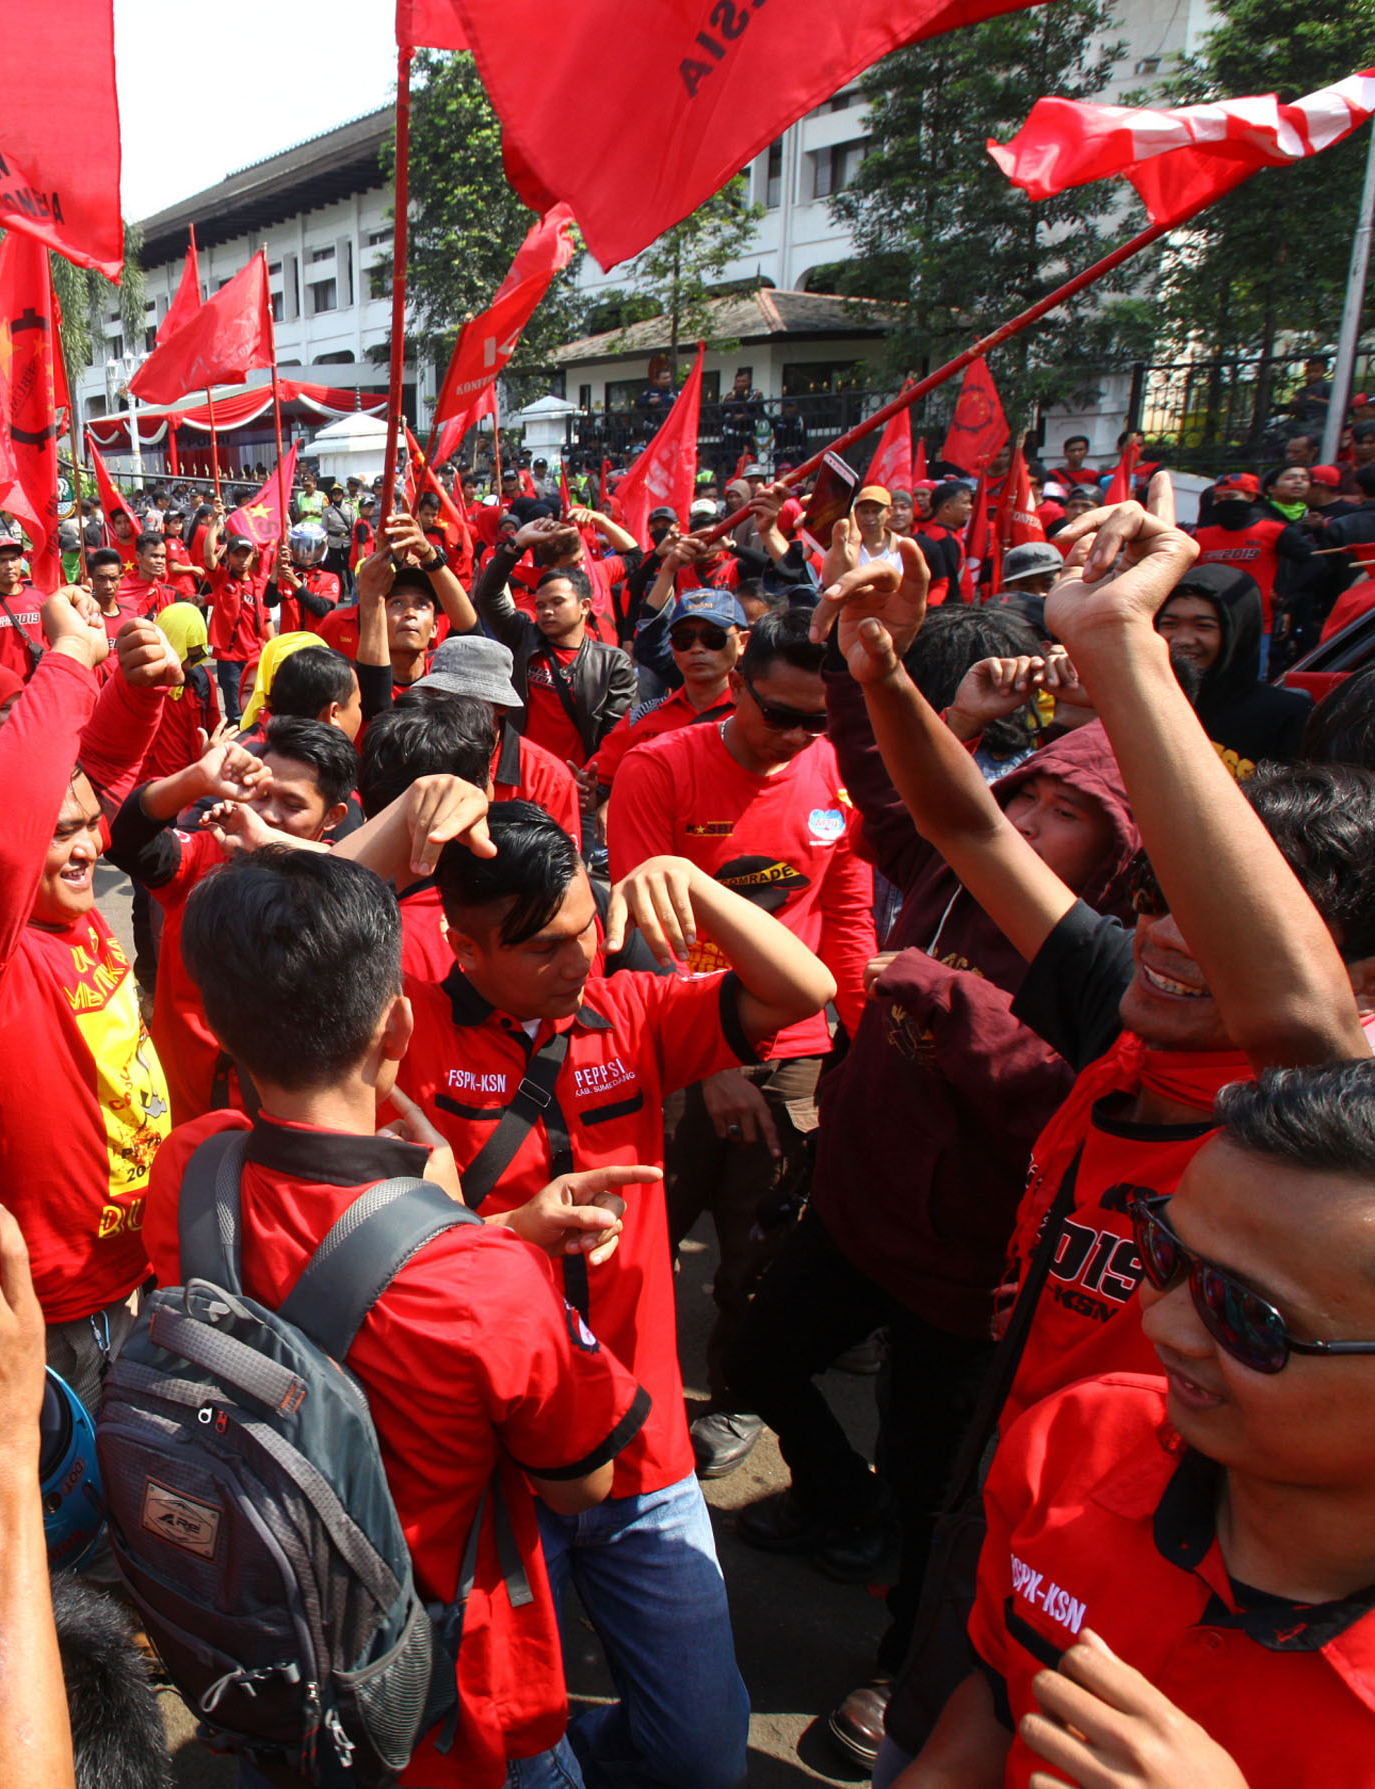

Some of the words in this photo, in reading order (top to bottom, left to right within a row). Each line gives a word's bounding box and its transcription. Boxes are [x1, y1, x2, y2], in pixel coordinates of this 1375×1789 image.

[448, 1069, 508, 1093] FSPK-KSN
[574, 1058, 626, 1089] PEPPSI
[593, 1071, 637, 1094] SUMEDANG
[1011, 1554, 1086, 1635] SPK-KSN
